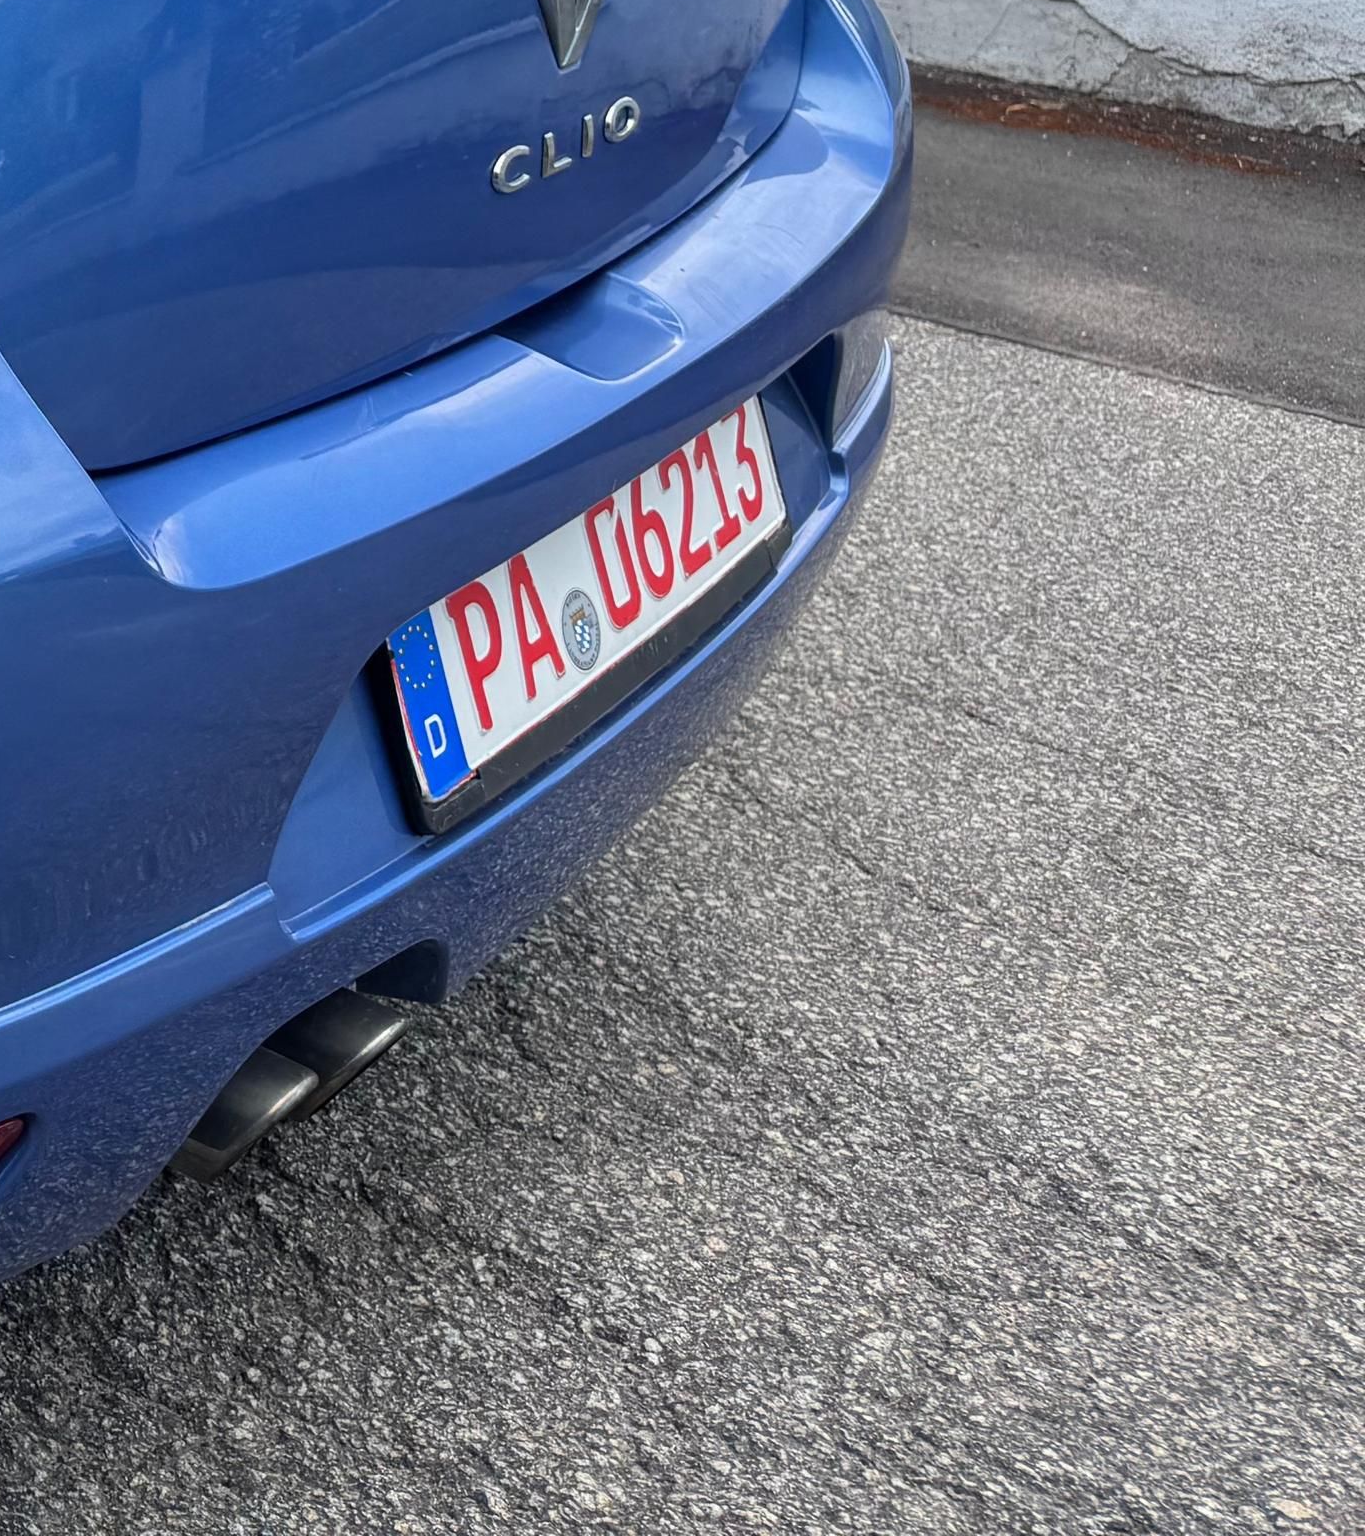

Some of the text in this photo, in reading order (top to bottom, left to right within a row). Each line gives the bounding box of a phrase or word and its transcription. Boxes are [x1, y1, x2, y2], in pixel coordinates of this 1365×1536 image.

[490, 95, 641, 194] CLIO
[444, 552, 567, 732] PA
[582, 402, 764, 630] 06213
[423, 713, 448, 759] D
